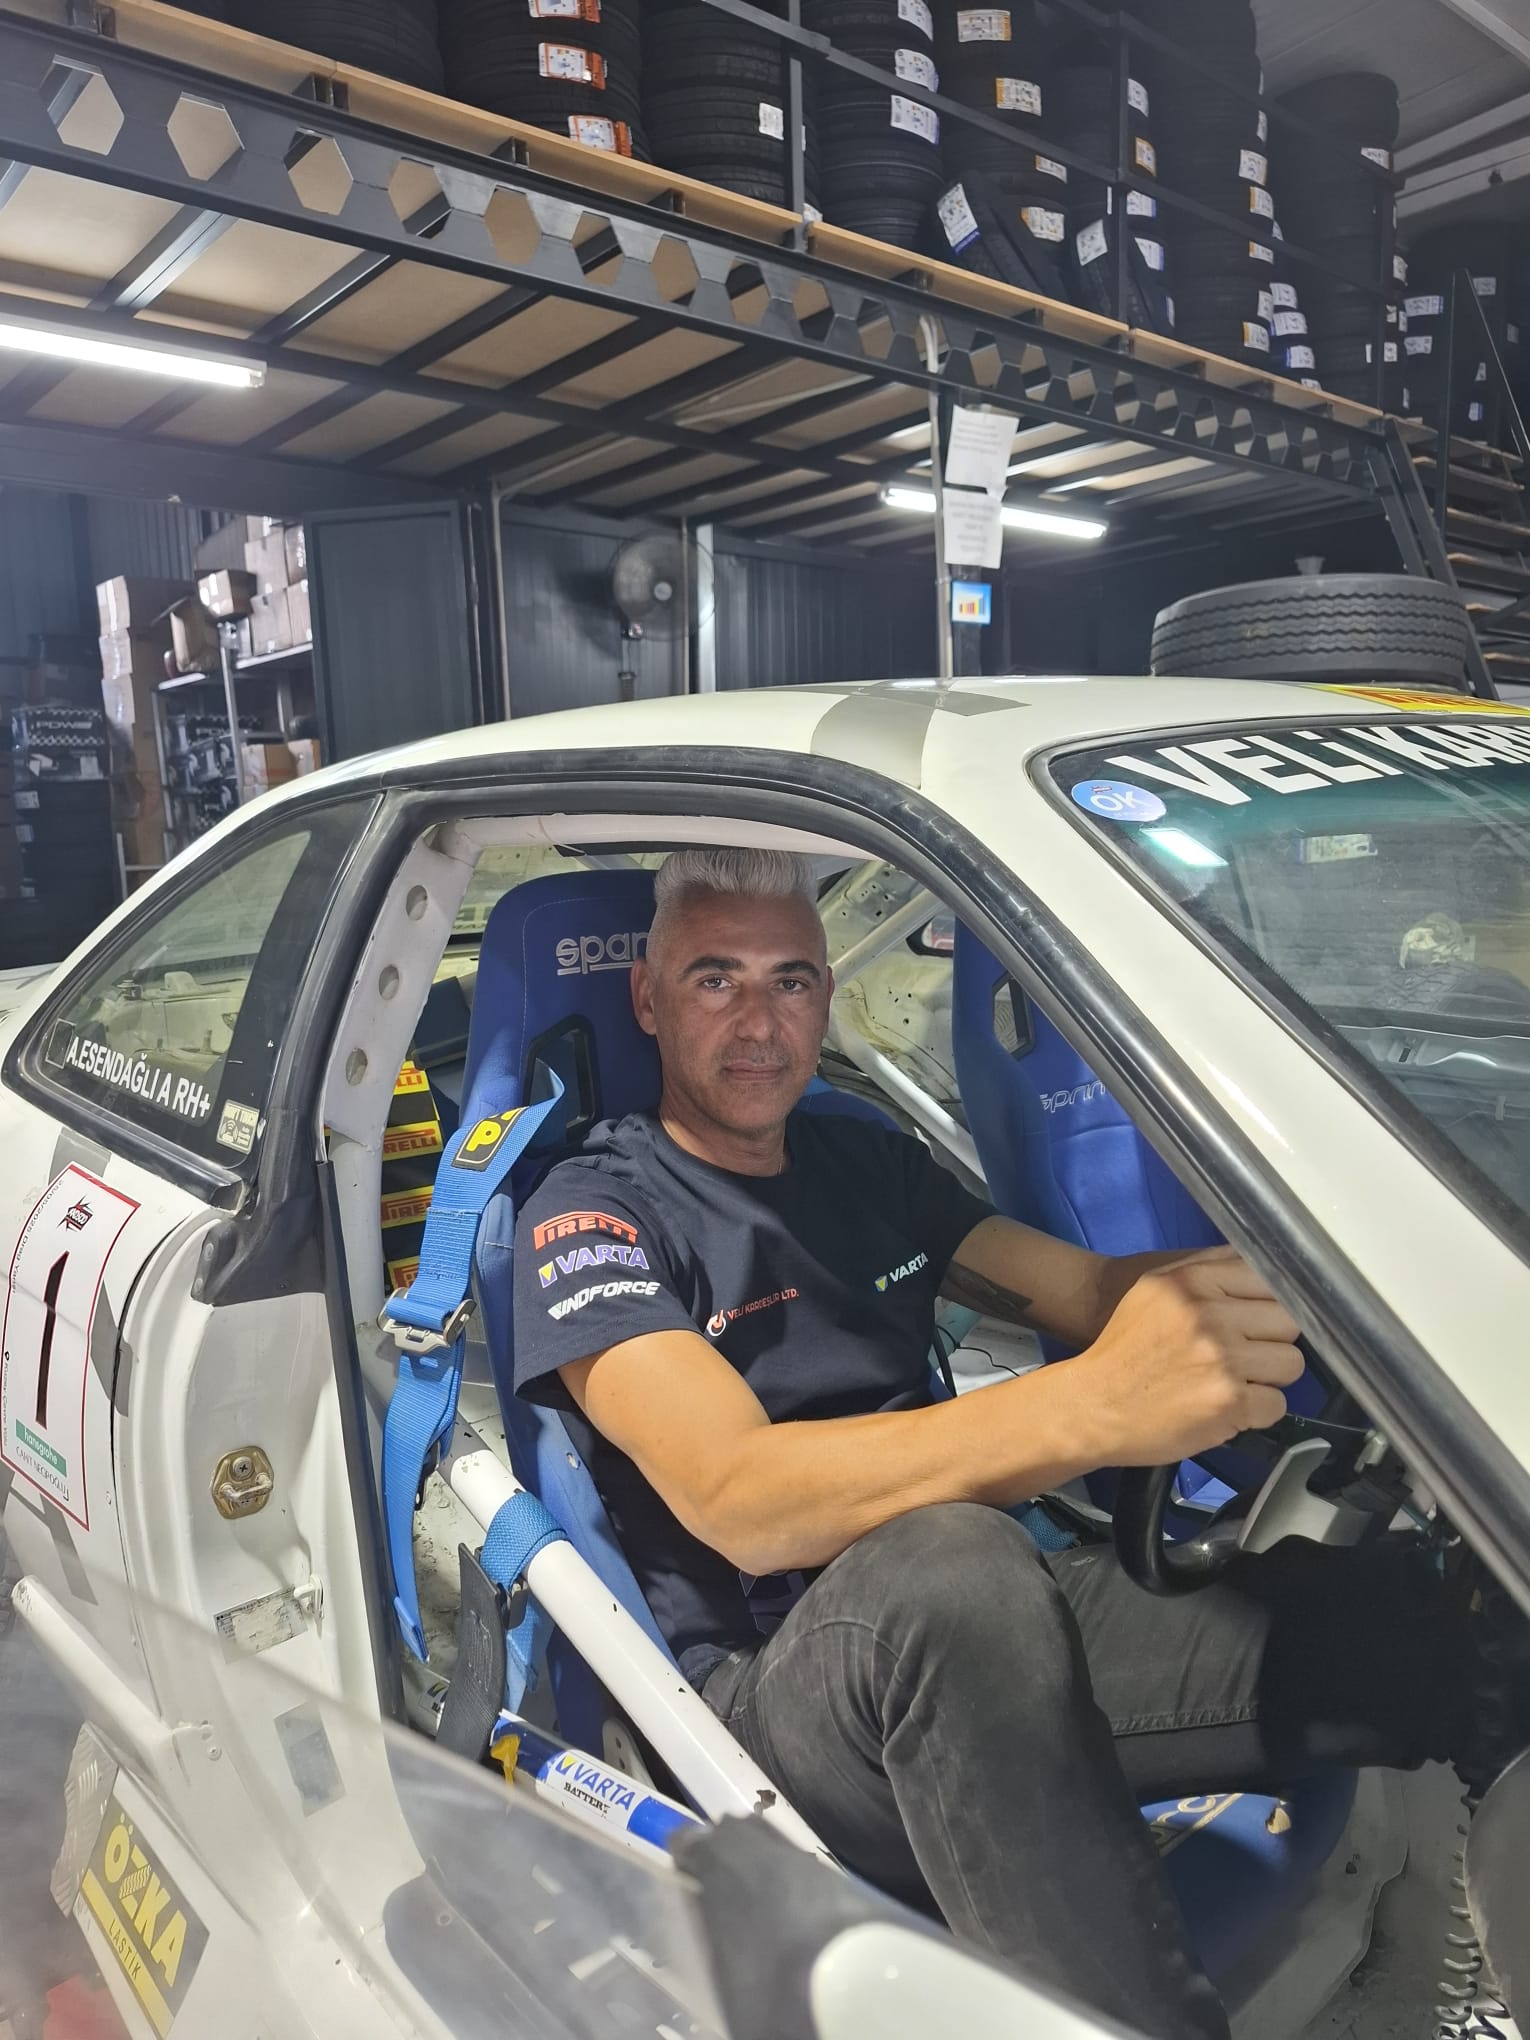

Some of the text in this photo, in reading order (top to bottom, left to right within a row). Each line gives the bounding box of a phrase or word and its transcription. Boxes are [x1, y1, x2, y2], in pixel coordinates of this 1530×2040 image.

[1090, 790, 1152, 812] OK
[156, 1072, 172, 1107] A
[172, 1077, 211, 1118] RH+
[555, 1244, 650, 1274] VARTA
[889, 1252, 929, 1283] VARTA
[36, 1250, 69, 1430] 1
[573, 1763, 637, 1811] VARTA
[104, 1812, 188, 1988] ÖZKA
